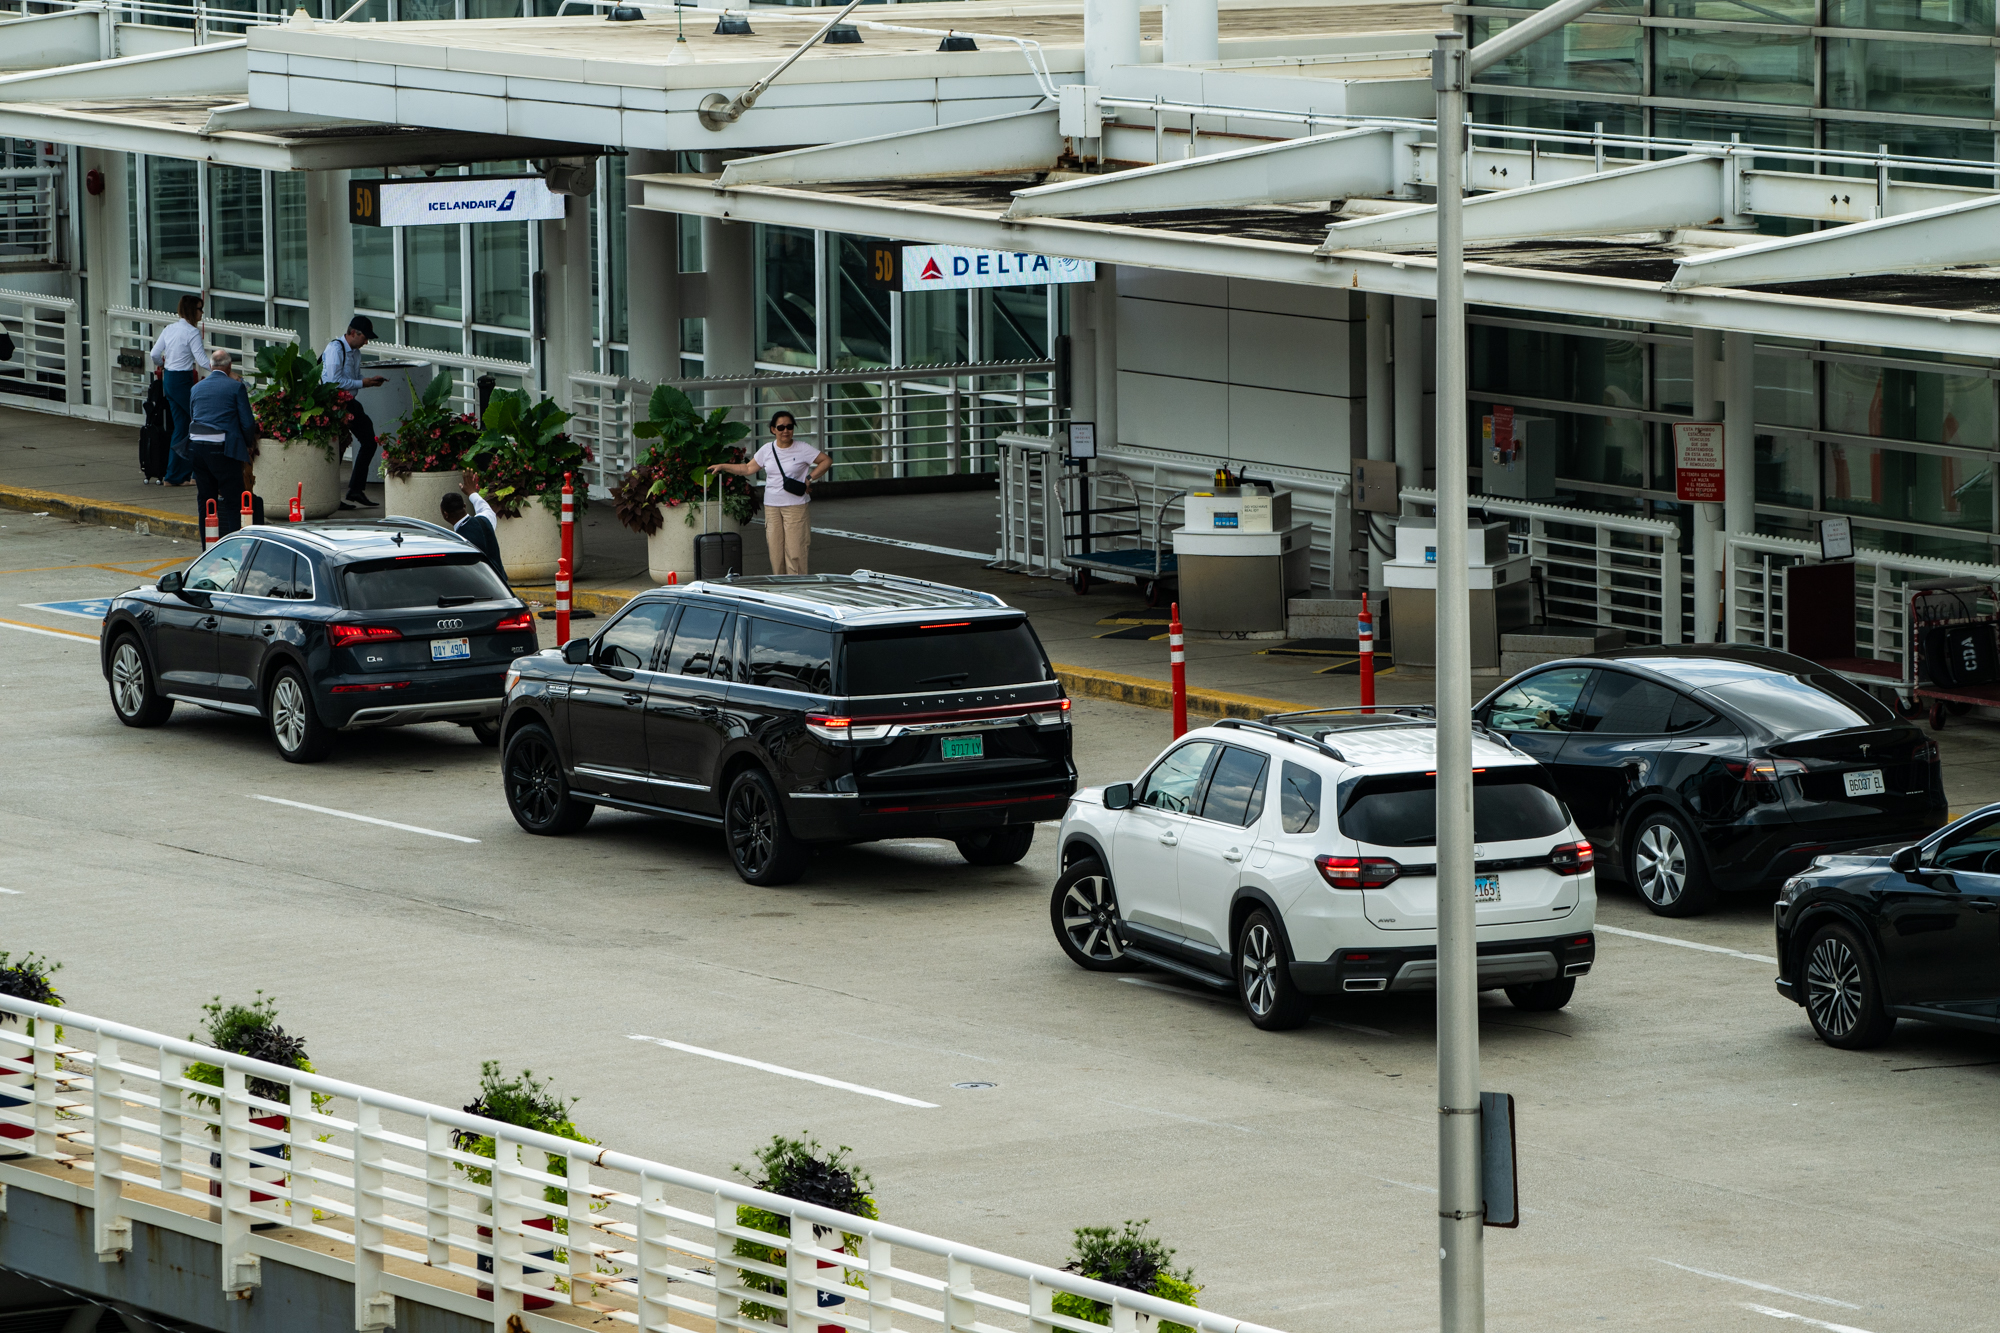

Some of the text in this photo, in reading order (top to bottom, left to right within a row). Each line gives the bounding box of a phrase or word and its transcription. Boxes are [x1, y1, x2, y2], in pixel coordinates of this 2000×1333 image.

[356, 187, 372, 217] 5D
[428, 200, 497, 211] ICELANDAIR
[875, 250, 893, 281] 5D
[953, 252, 1049, 276] DELTA
[1961, 637, 1978, 671] CDA
[903, 693, 1016, 706] LINCOLN
[951, 743, 969, 756] 9717
[972, 742, 981, 754] LY
